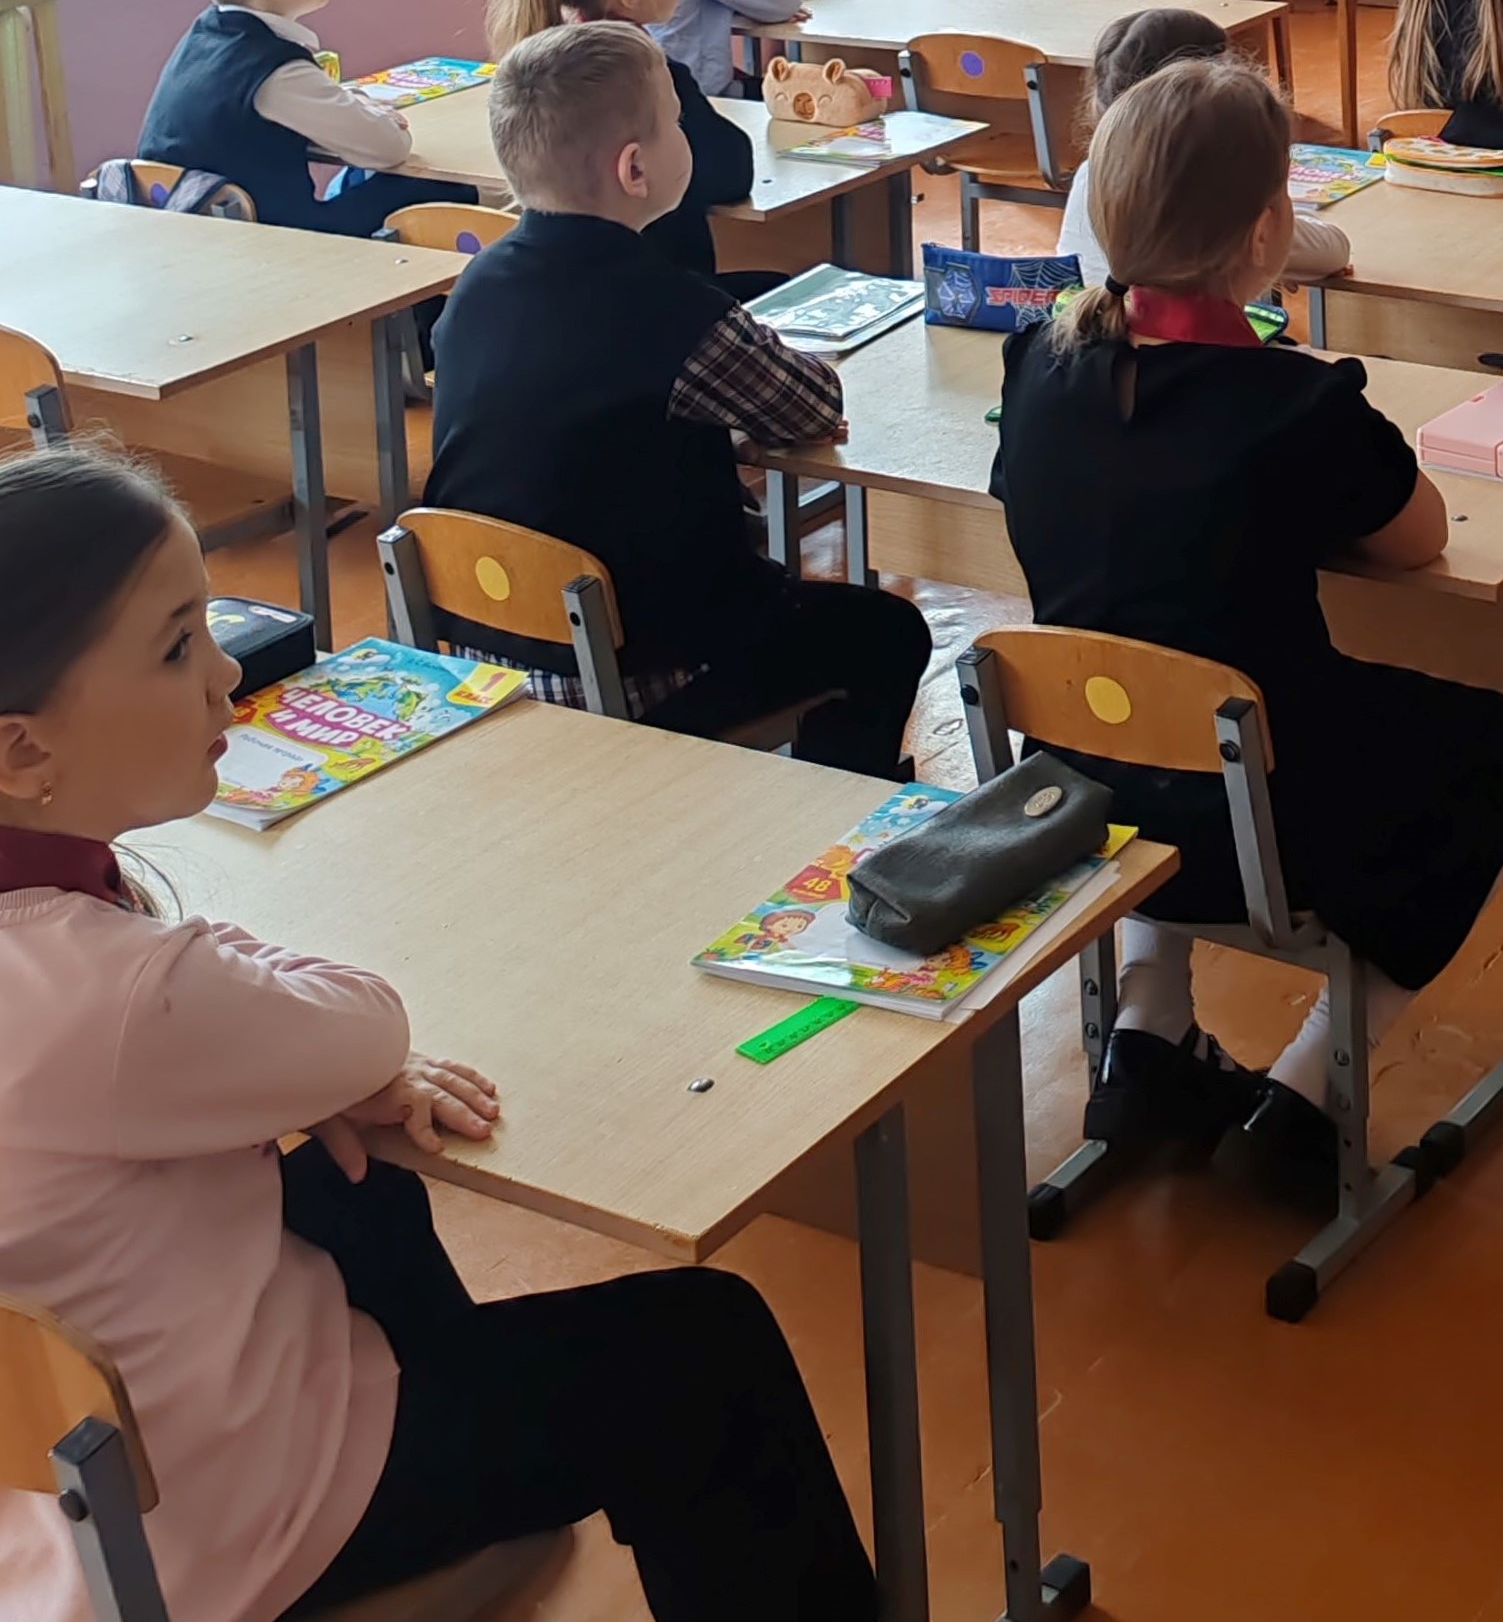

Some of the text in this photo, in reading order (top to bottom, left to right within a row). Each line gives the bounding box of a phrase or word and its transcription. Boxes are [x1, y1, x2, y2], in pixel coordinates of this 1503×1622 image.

[481, 671, 508, 692] 1
[269, 709, 298, 723] И
[285, 719, 360, 745] МИР
[282, 688, 408, 741] ЧЕЛОВЕК
[803, 876, 832, 893] 48
